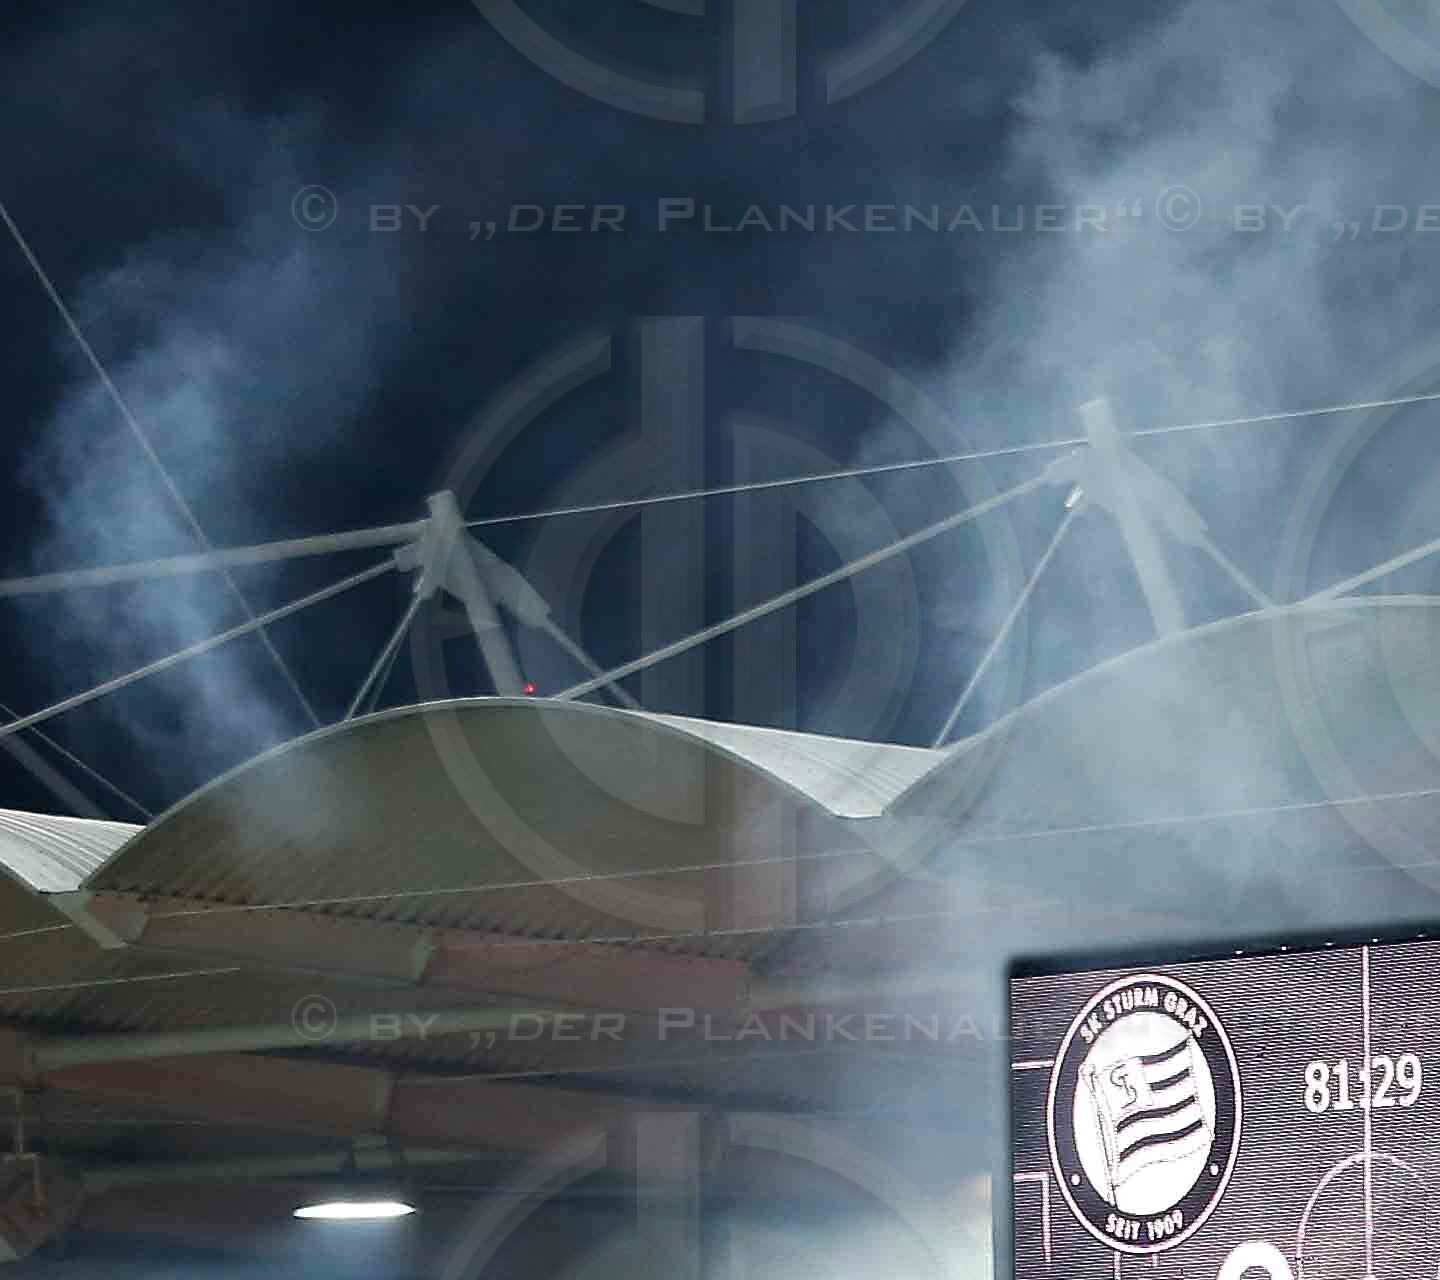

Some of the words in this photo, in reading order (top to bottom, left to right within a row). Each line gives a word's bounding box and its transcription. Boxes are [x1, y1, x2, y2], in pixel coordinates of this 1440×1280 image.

[1102, 986, 1161, 1021] STURM
[1161, 993, 1210, 1037] GRAZ
[1104, 1211, 1142, 1243] SEIT
[1145, 1210, 1184, 1241] 1909
